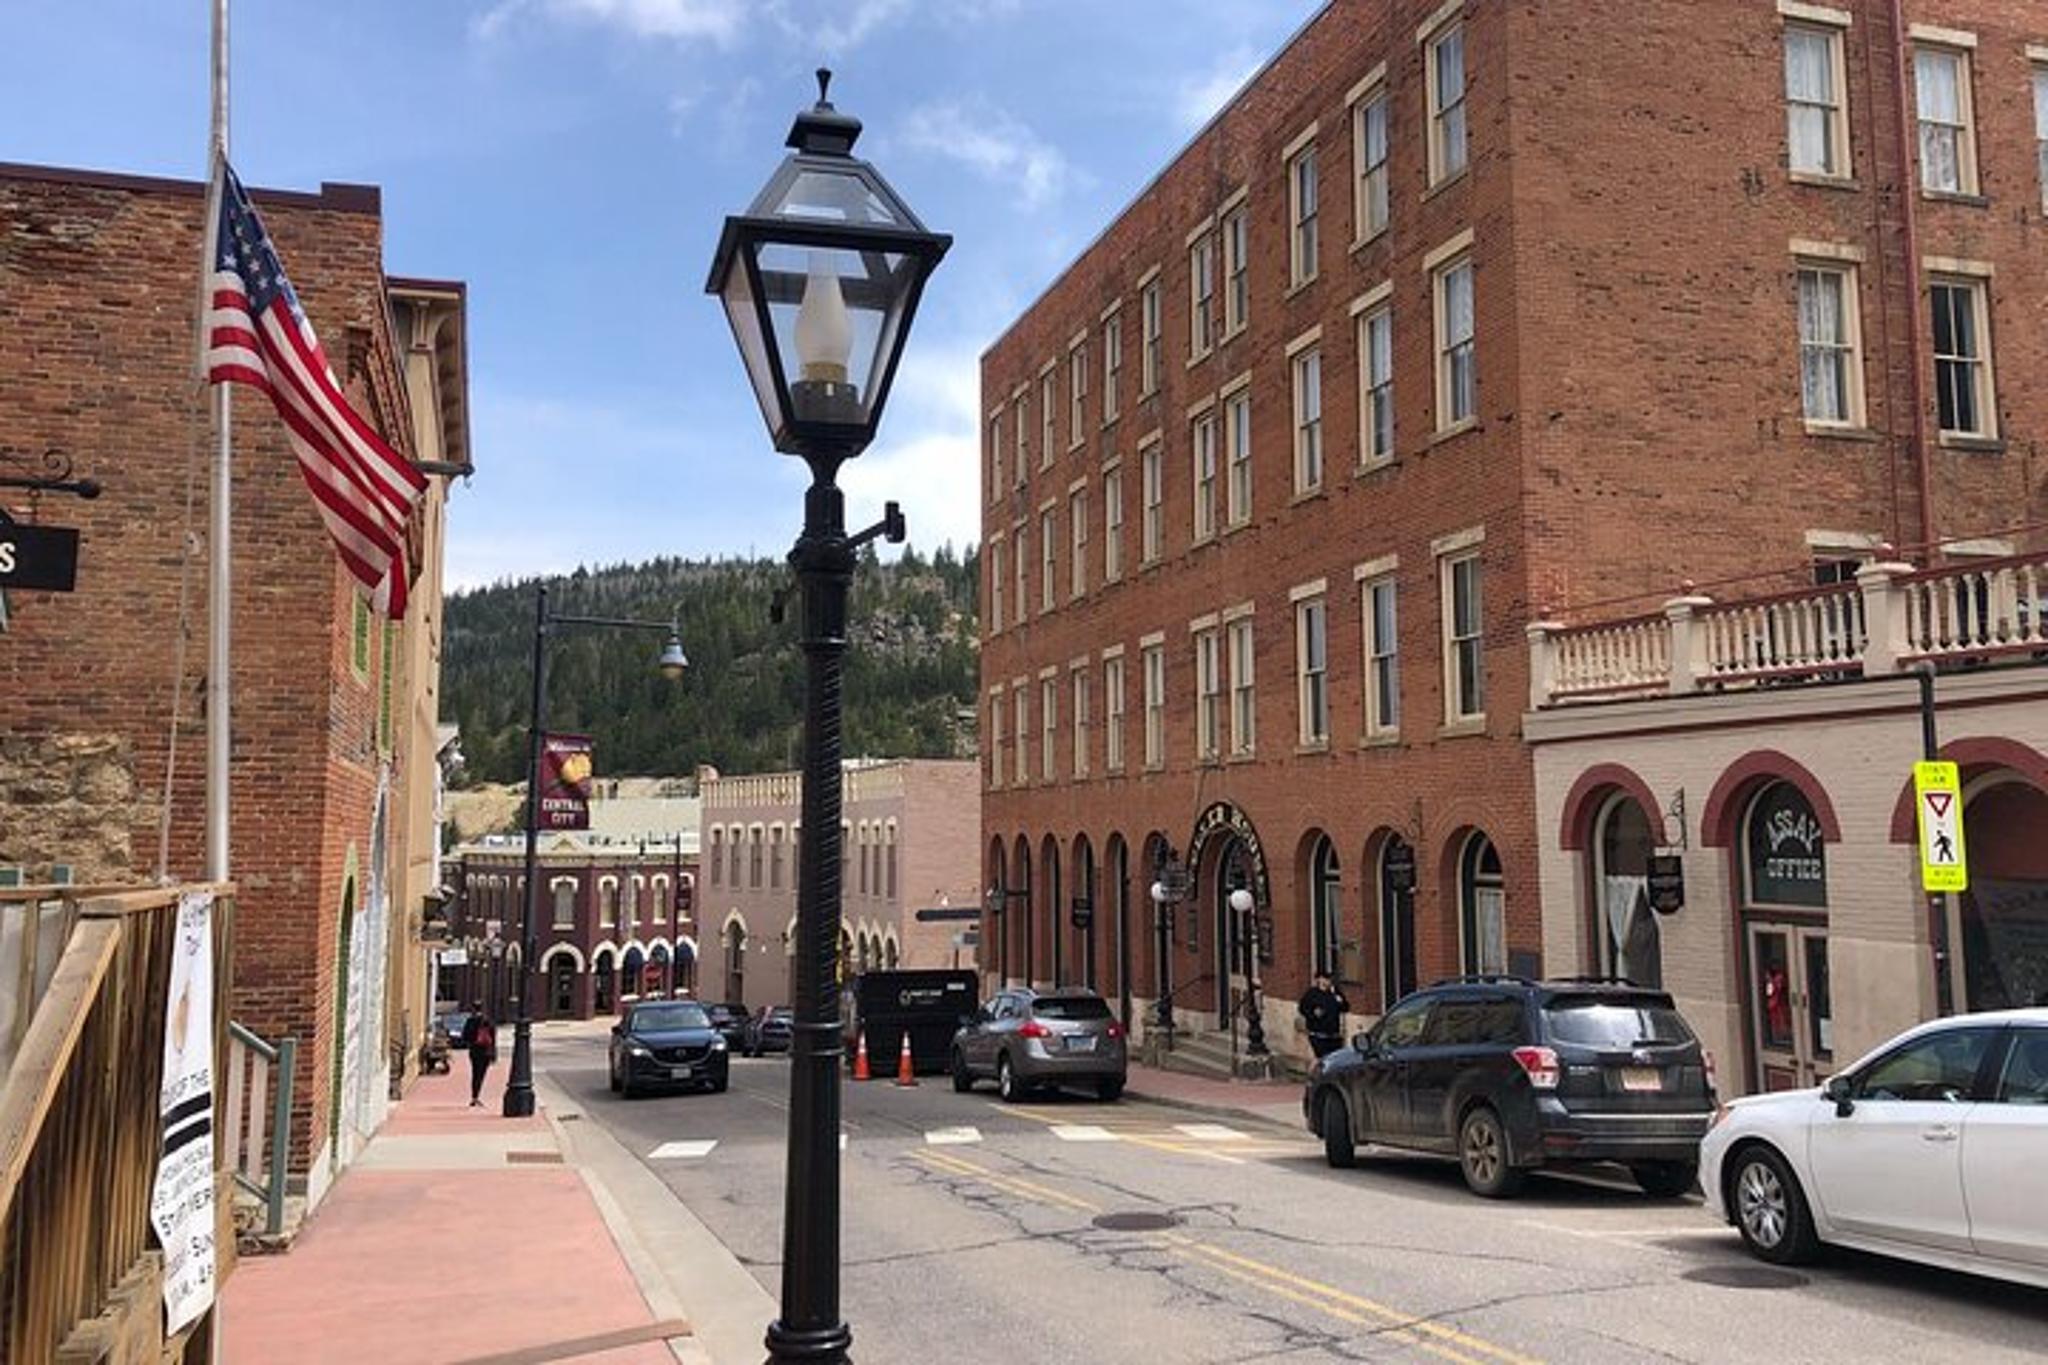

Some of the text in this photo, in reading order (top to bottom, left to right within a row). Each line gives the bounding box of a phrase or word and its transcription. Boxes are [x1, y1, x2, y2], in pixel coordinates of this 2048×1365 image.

[542, 798, 585, 811] CENTRAL
[551, 812, 576, 825] CITY
[1766, 808, 1822, 854] ASSAY
[1767, 858, 1821, 880] OFFICE
